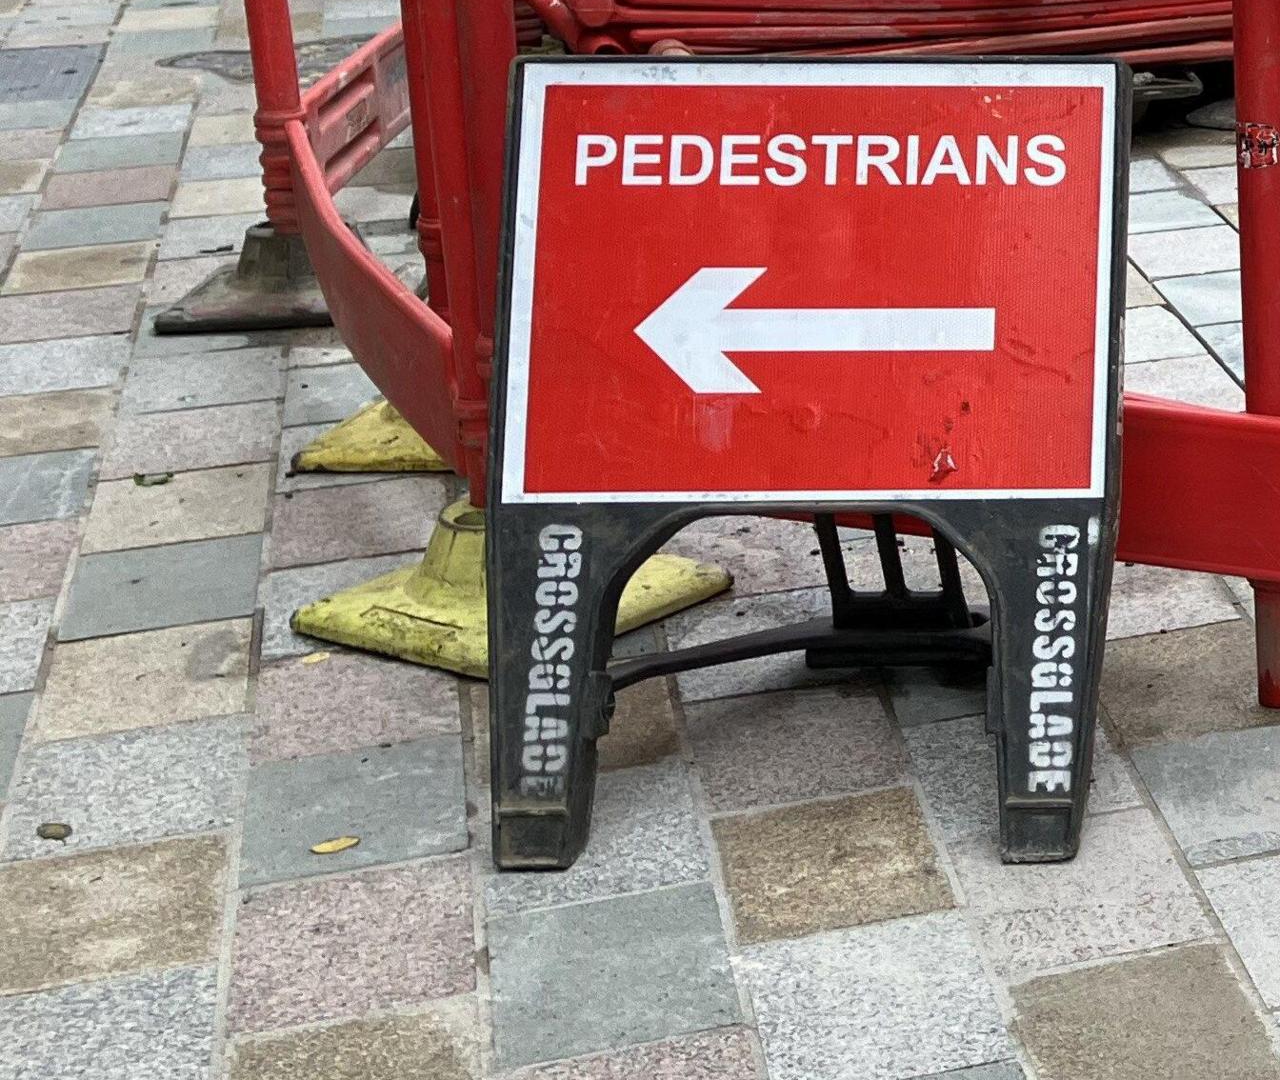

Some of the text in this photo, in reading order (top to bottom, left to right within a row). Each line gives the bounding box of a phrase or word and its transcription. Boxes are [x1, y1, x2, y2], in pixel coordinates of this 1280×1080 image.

[574, 133, 1068, 188] PEDESTRIANS
[520, 523, 582, 797] CROSSGLADE
[1028, 523, 1082, 794] CROSSGLADE
